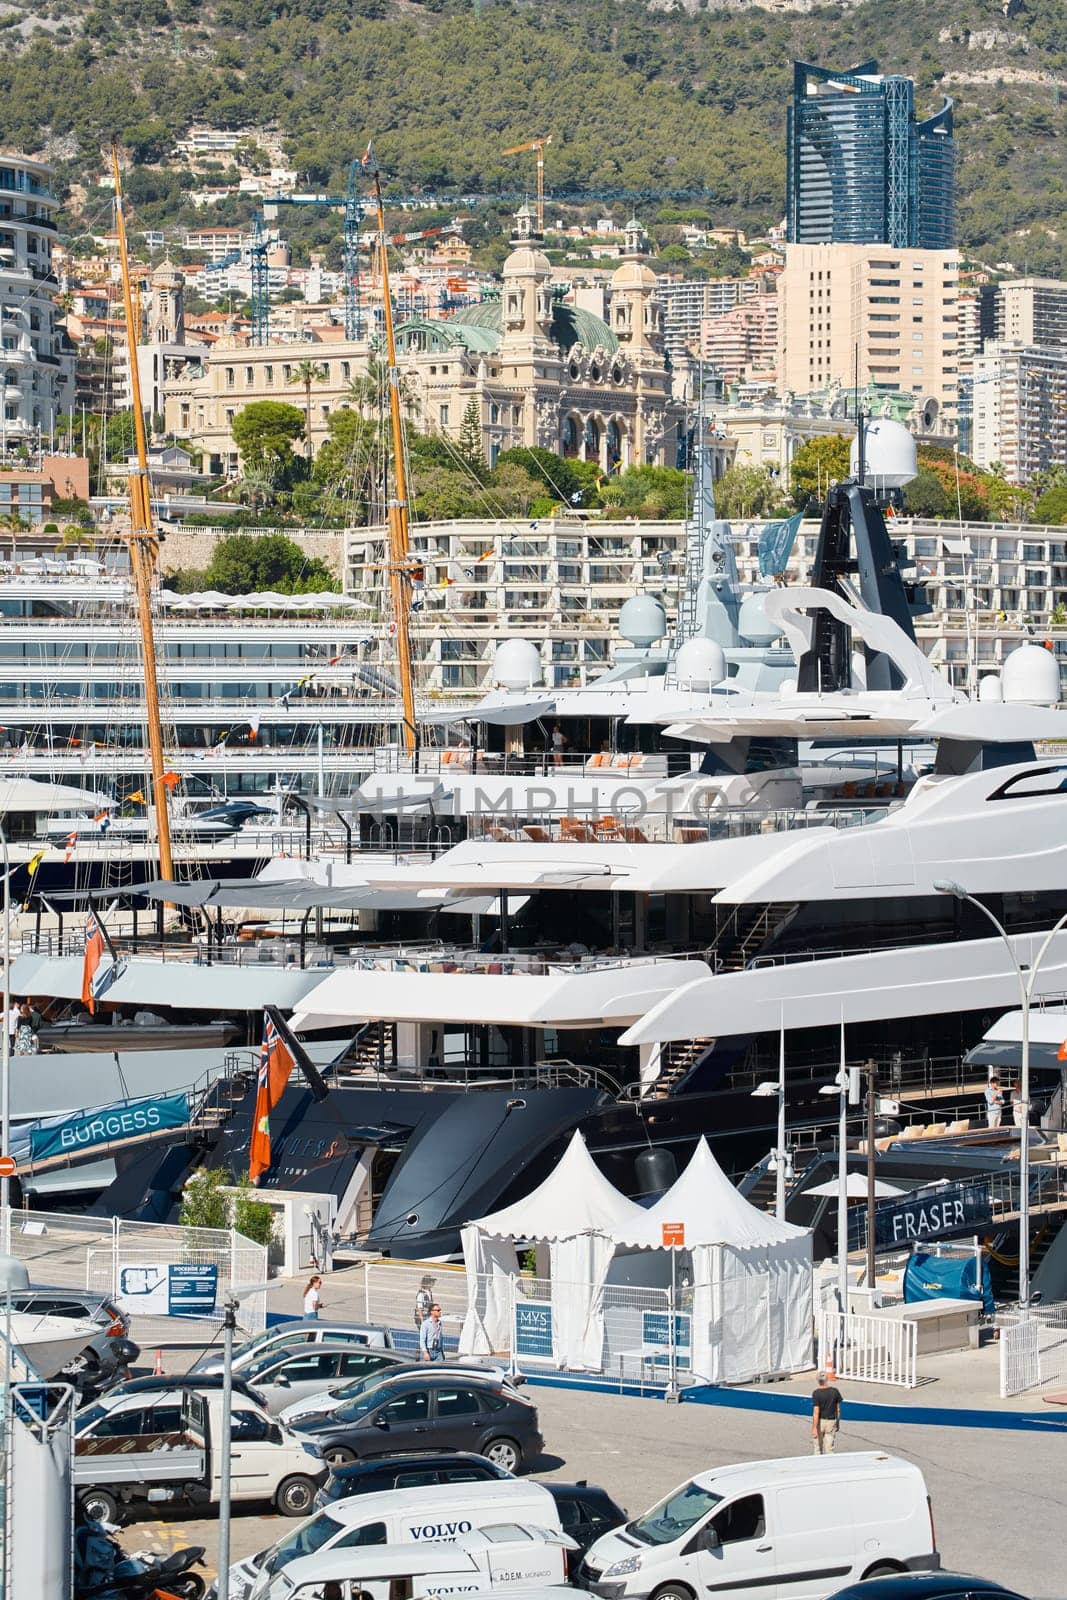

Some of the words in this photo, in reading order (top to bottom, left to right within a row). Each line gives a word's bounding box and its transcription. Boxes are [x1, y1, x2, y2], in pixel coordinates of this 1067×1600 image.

[61, 1107, 160, 1147] BURGESS
[892, 1200, 965, 1241] FRASER
[520, 1311, 547, 1326] MYS
[409, 1520, 472, 1540] VOLVO
